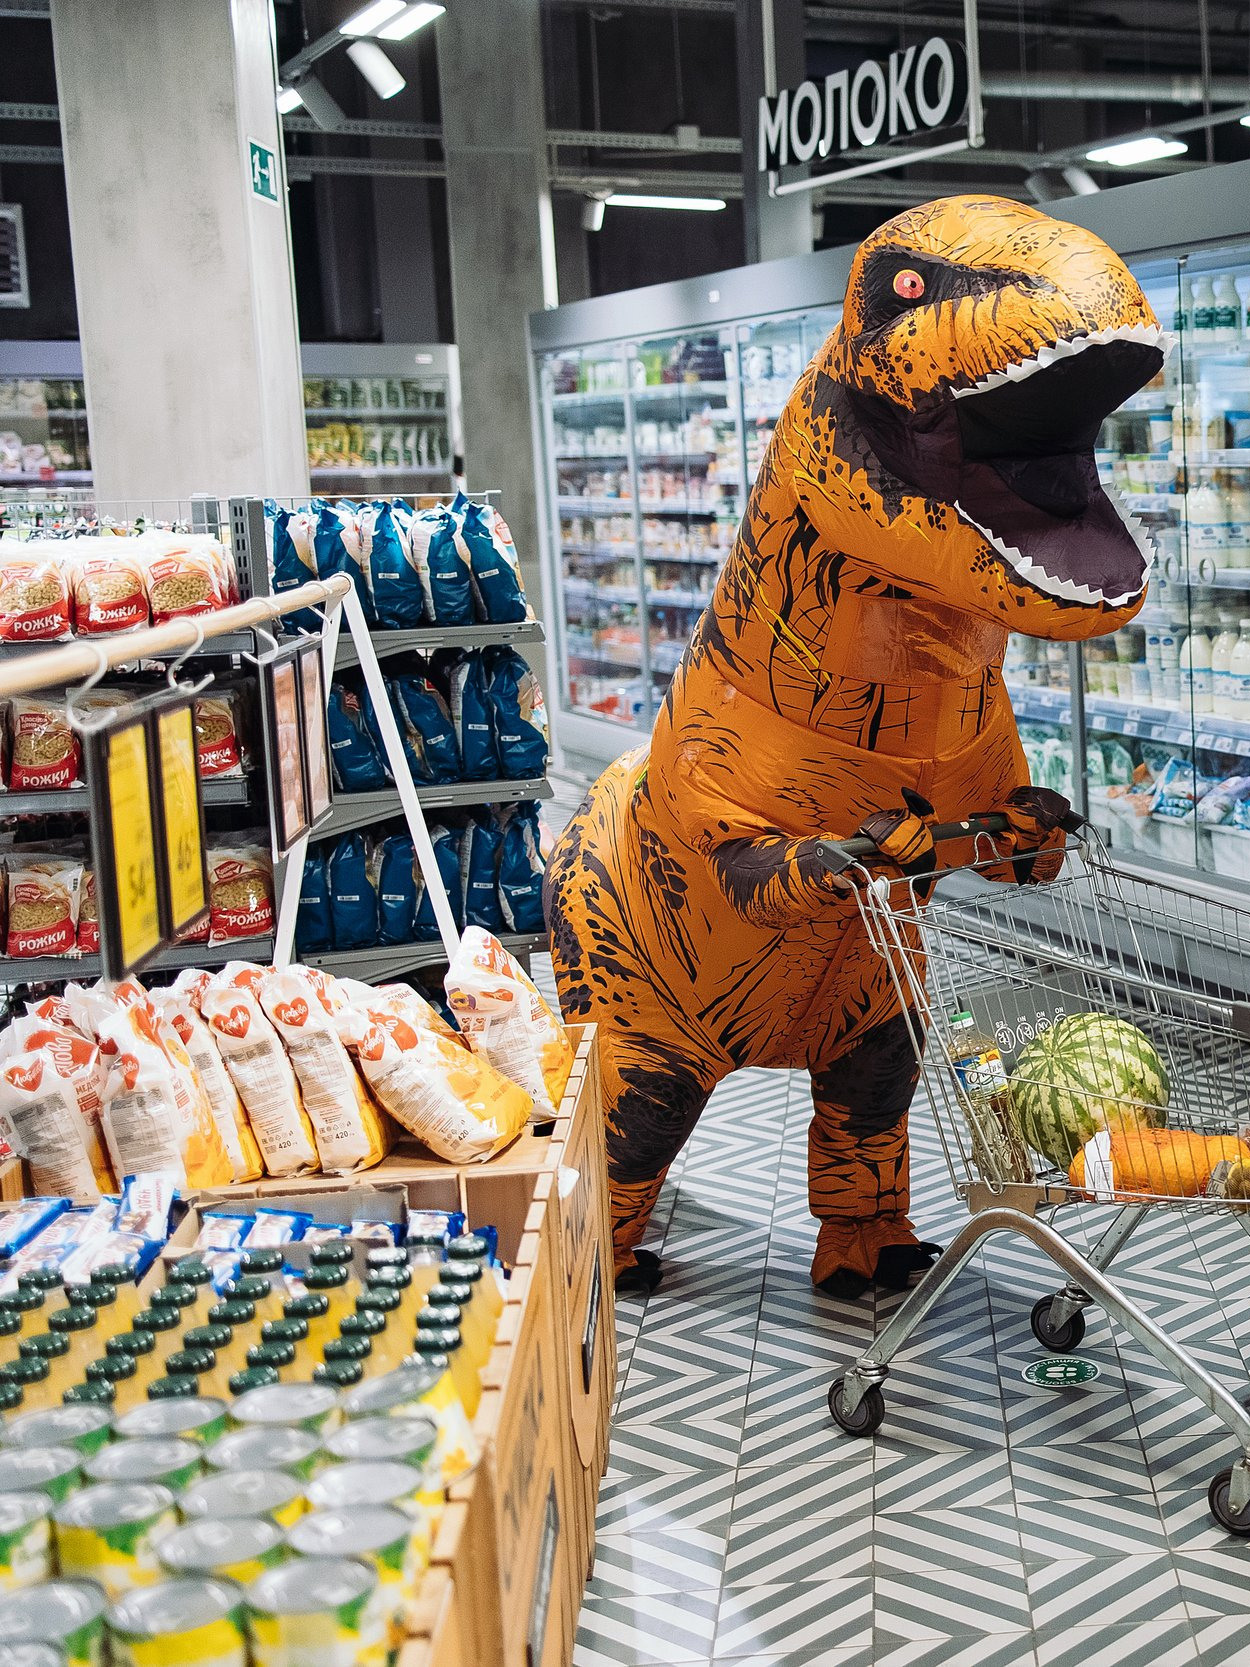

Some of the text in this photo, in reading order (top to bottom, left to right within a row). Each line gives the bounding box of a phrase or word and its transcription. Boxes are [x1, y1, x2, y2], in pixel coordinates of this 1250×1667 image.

[758, 36, 955, 172] МОЛОКО
[92, 604, 137, 621] ОЖКИ
[22, 768, 70, 787] РОЖКИ
[228, 907, 272, 927] РОЖКИ
[19, 930, 66, 951] РОЖКИ
[335, 1130, 349, 1140] 420
[458, 1129, 470, 1141] 420
[278, 1140, 292, 1150] 420
